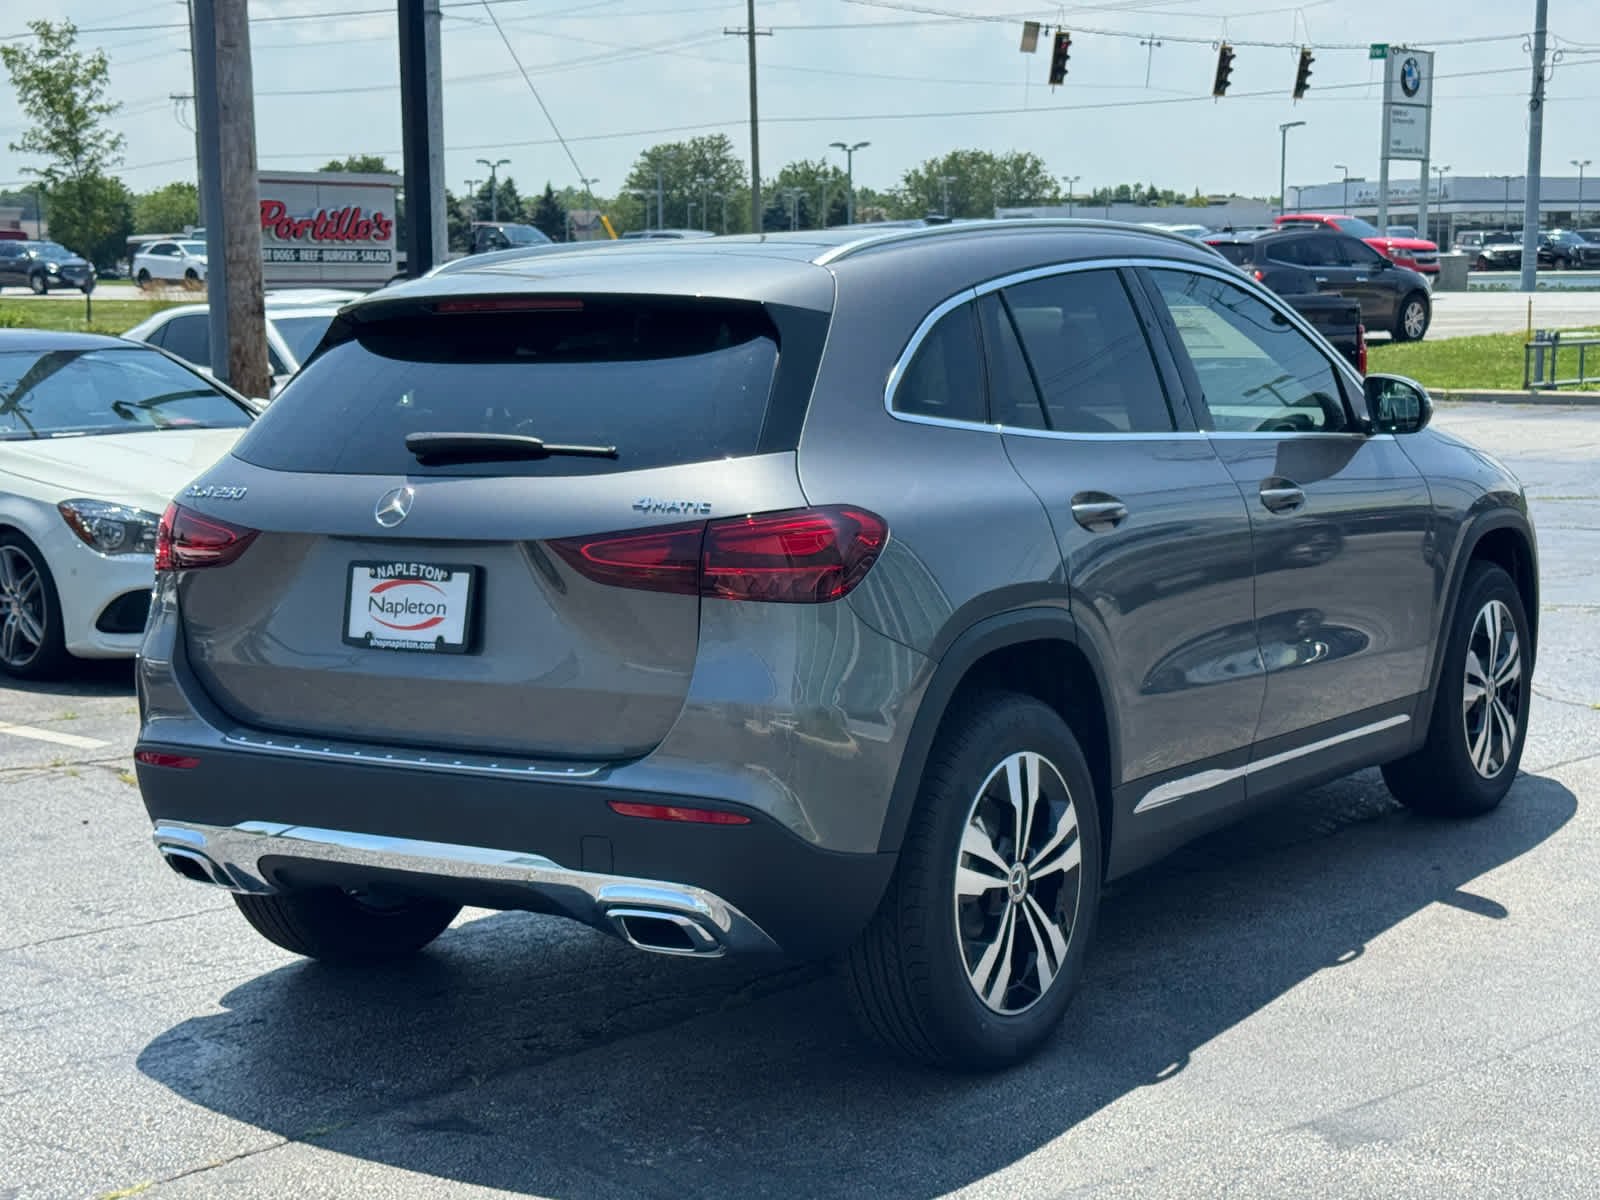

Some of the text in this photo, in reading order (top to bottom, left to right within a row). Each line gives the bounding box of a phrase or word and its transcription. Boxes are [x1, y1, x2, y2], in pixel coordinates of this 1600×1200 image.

[259, 200, 393, 241] Portillo's
[262, 250, 389, 262] OT DOGS BEEF BURGERS SALADS
[632, 498, 711, 513] 4MATIC
[377, 563, 444, 581] NAPLETON
[368, 596, 447, 618] Napleton
[369, 639, 436, 650] shopnapleton.com
